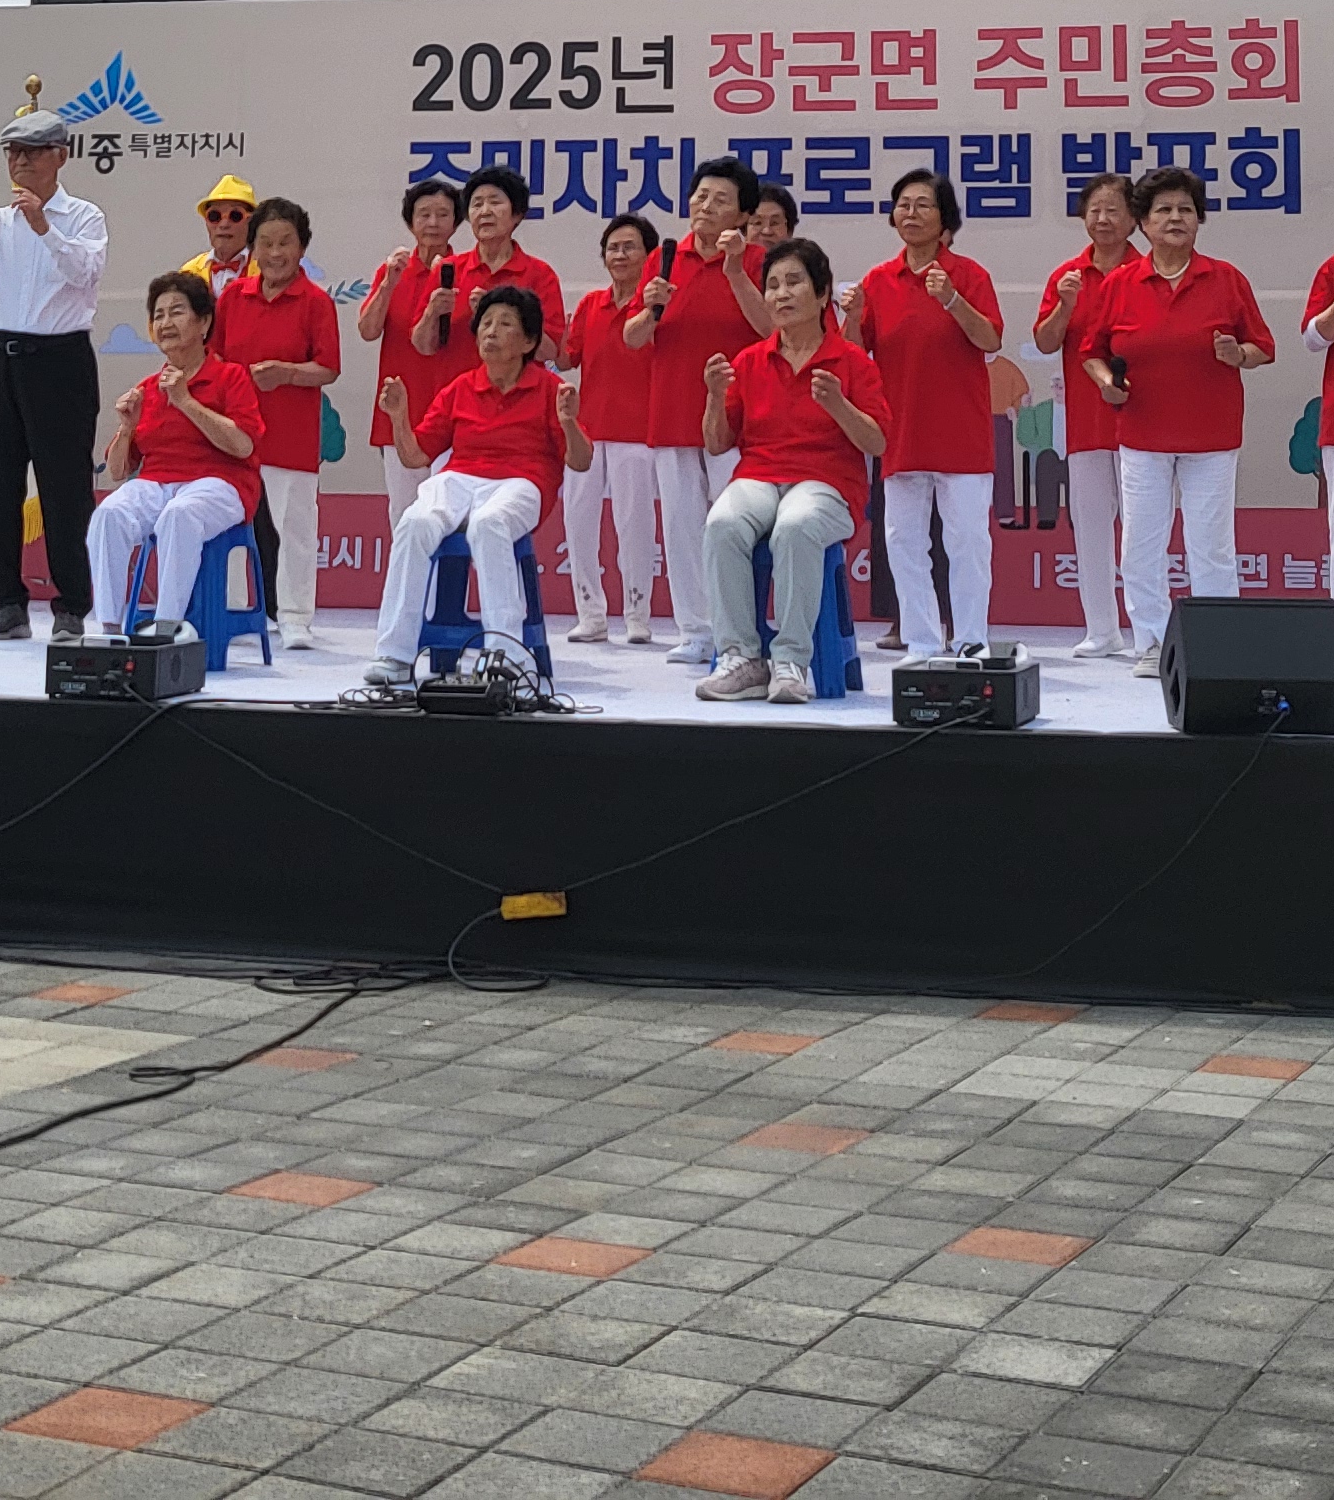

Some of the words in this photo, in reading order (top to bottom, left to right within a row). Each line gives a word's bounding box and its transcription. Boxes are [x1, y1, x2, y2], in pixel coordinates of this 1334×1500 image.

[411, 34, 675, 114] 2025년
[708, 28, 939, 115] 장군면
[973, 18, 1302, 110] 주민총회
[127, 131, 246, 159] 특별자치시
